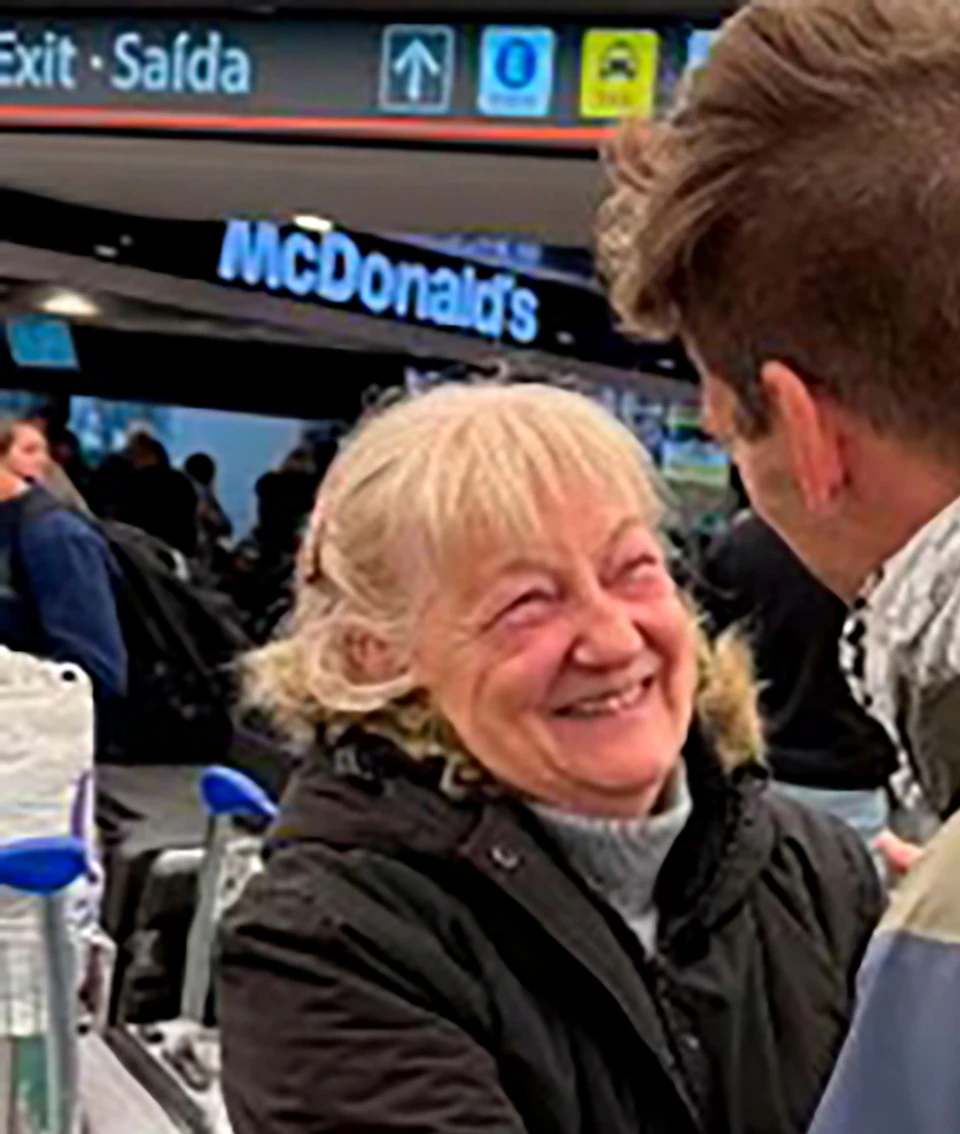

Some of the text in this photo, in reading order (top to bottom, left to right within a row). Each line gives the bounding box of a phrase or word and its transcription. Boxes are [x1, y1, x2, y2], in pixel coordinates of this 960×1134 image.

[0, 31, 250, 94] Exit Saída
[217, 219, 540, 344] McDonald's
